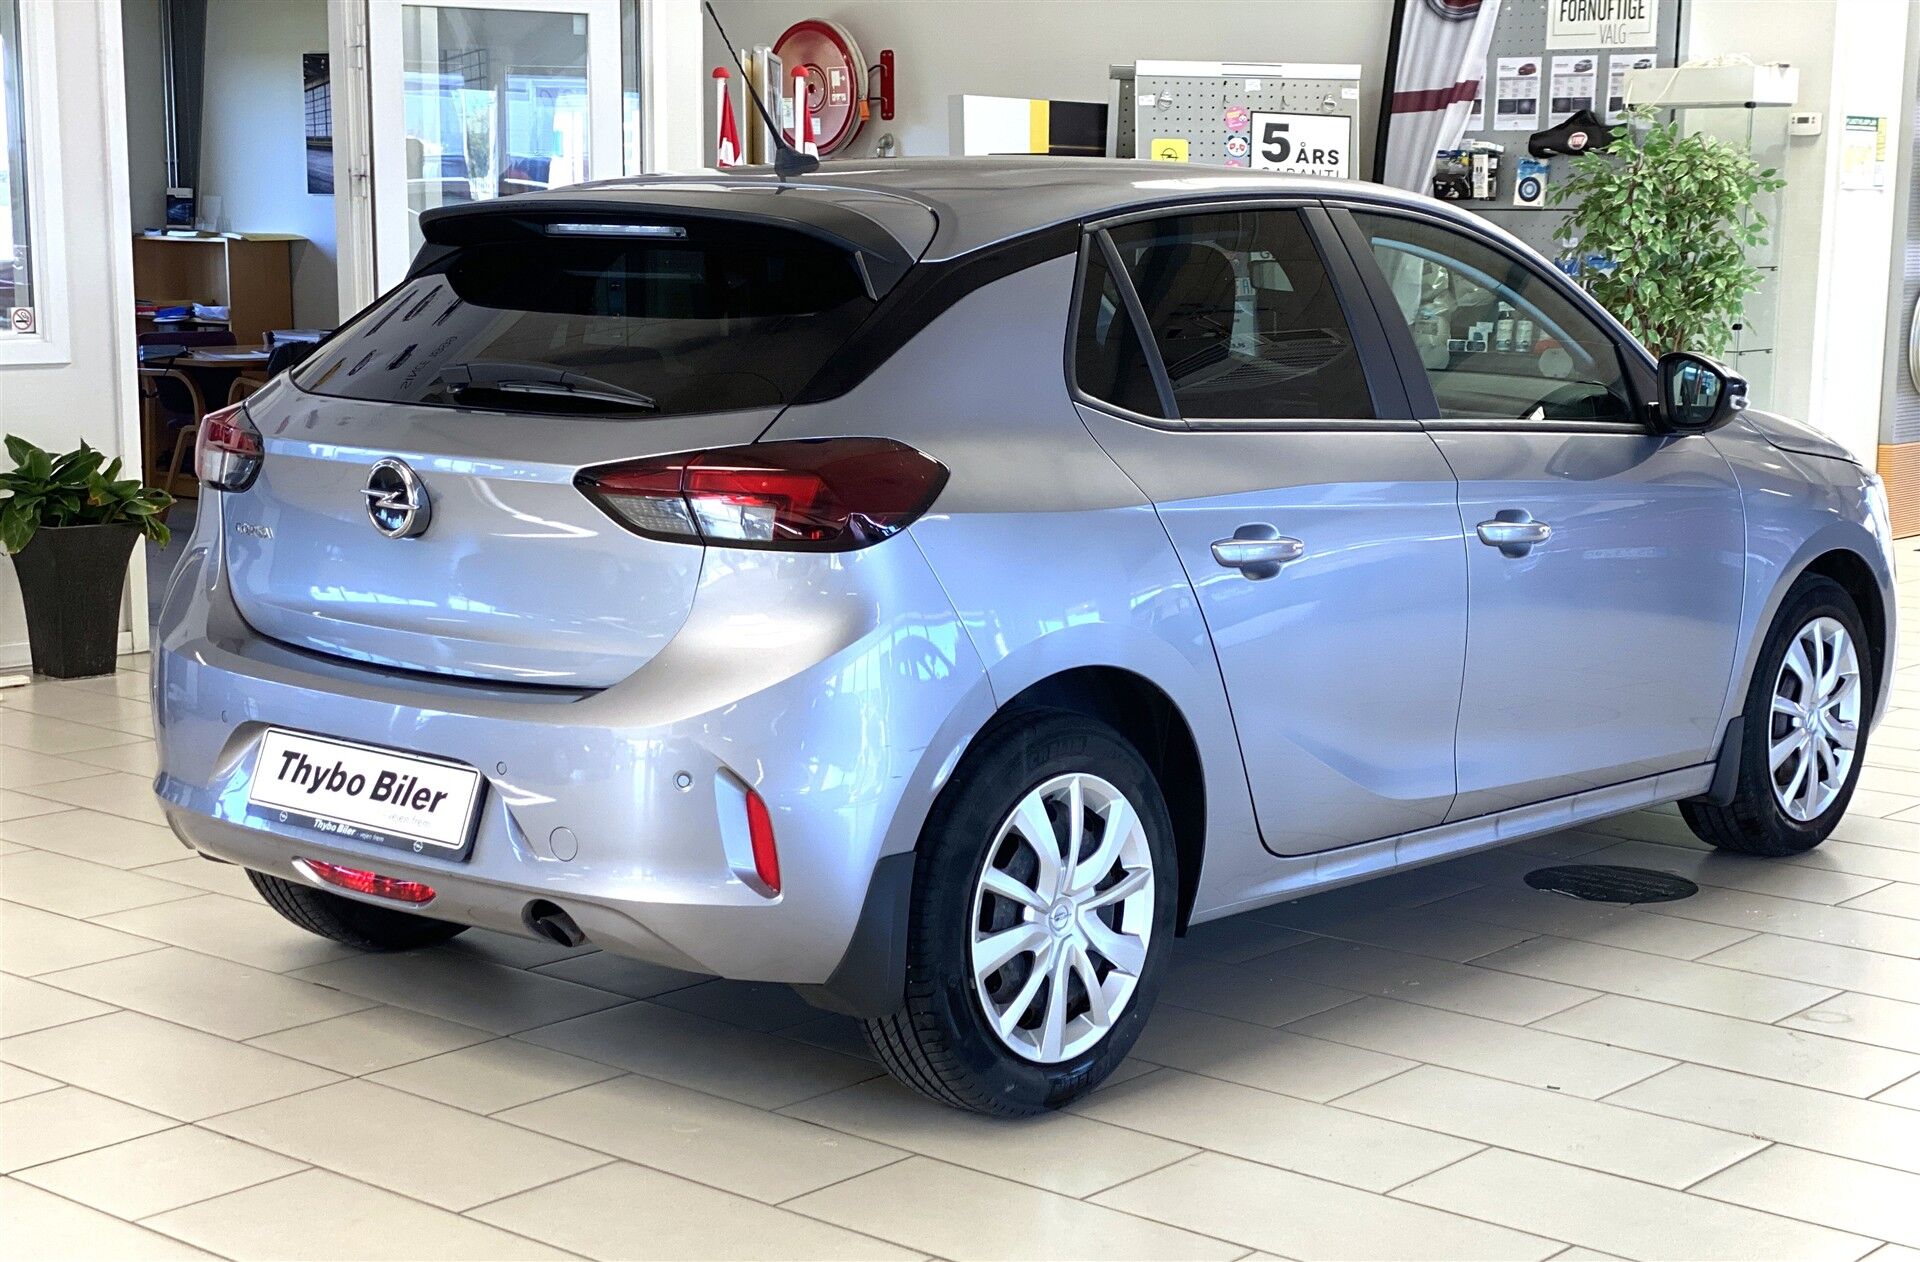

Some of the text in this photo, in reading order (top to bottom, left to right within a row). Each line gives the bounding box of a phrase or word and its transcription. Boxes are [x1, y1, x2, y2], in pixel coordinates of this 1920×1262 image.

[1599, 23, 1627, 45] VALG
[1261, 122, 1340, 165] 5 ÅRS
[277, 750, 448, 814] Thybo Biler
[313, 818, 337, 832] Thybo
[336, 823, 357, 836] Biler
